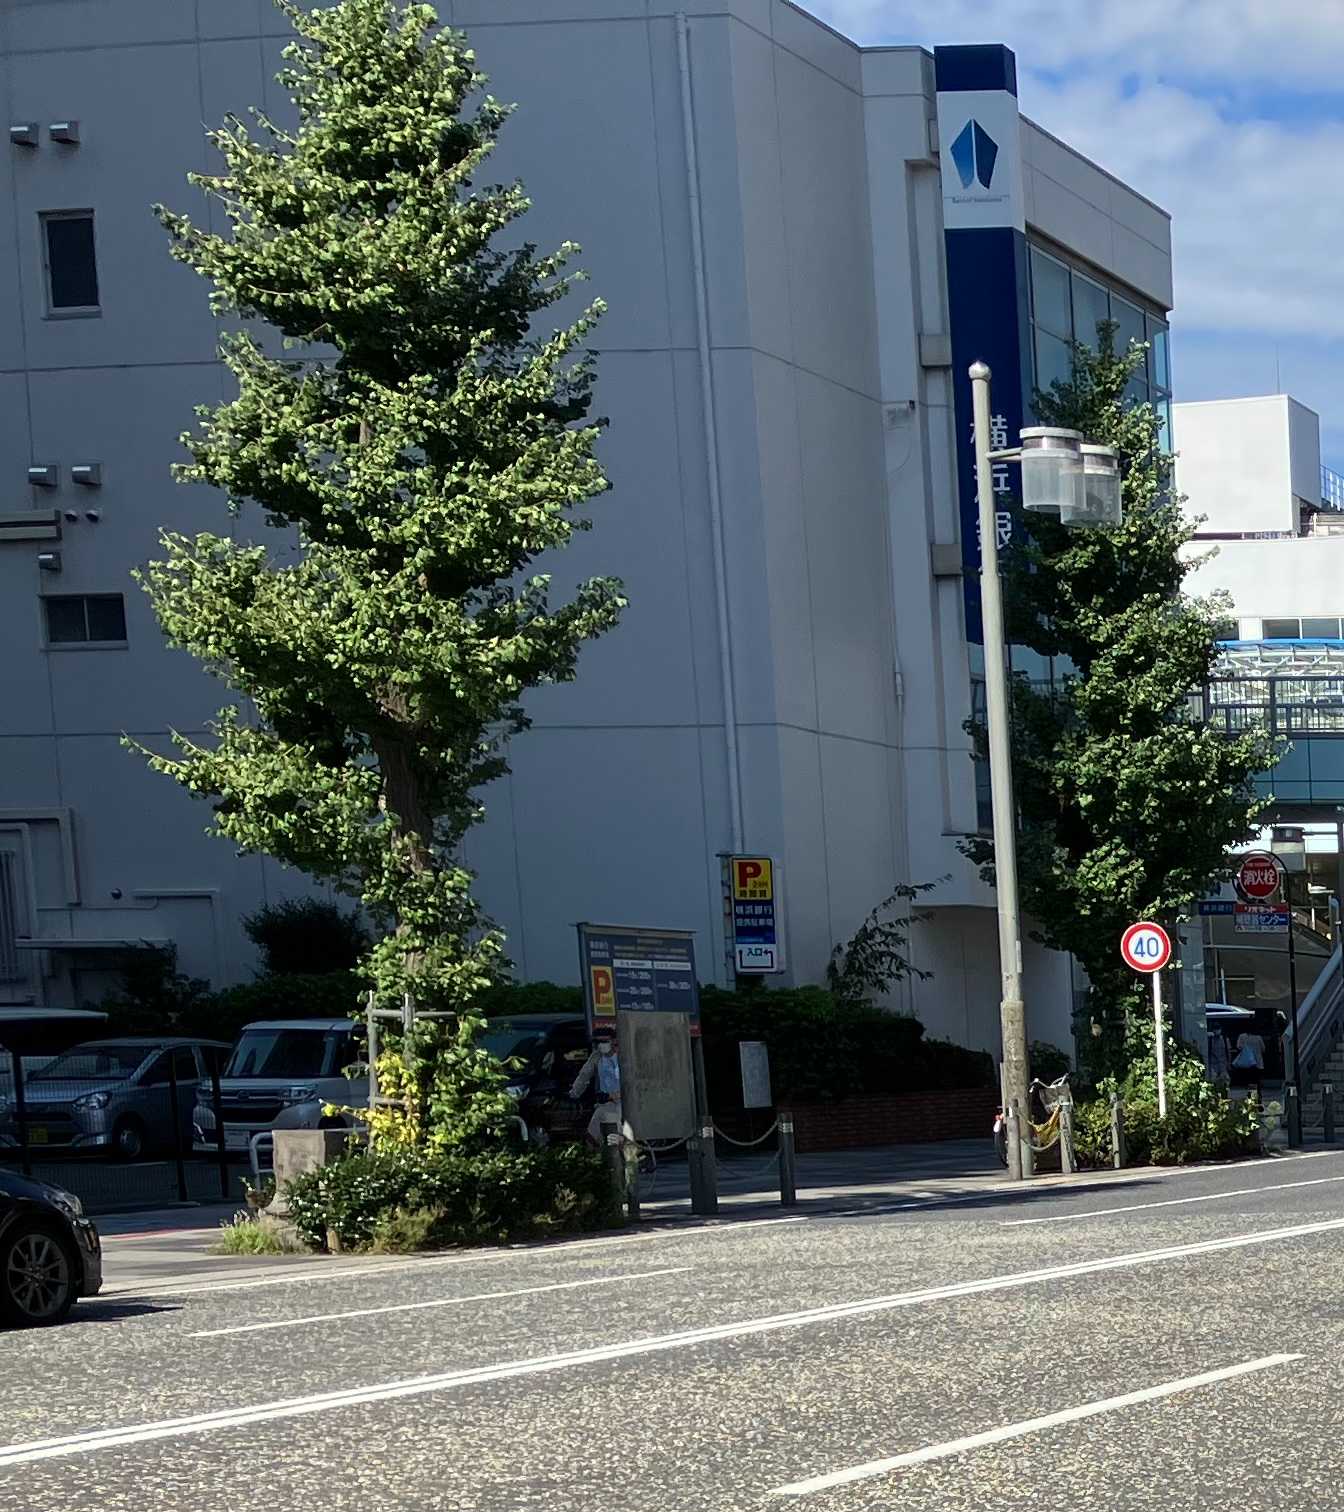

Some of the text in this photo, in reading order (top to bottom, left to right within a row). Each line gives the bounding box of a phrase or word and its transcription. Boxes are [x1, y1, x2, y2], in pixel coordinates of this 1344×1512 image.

[737, 861, 762, 888] P
[1243, 869, 1276, 885] 消火栓
[747, 947, 762, 956] 入口
[1133, 936, 1160, 958] 40
